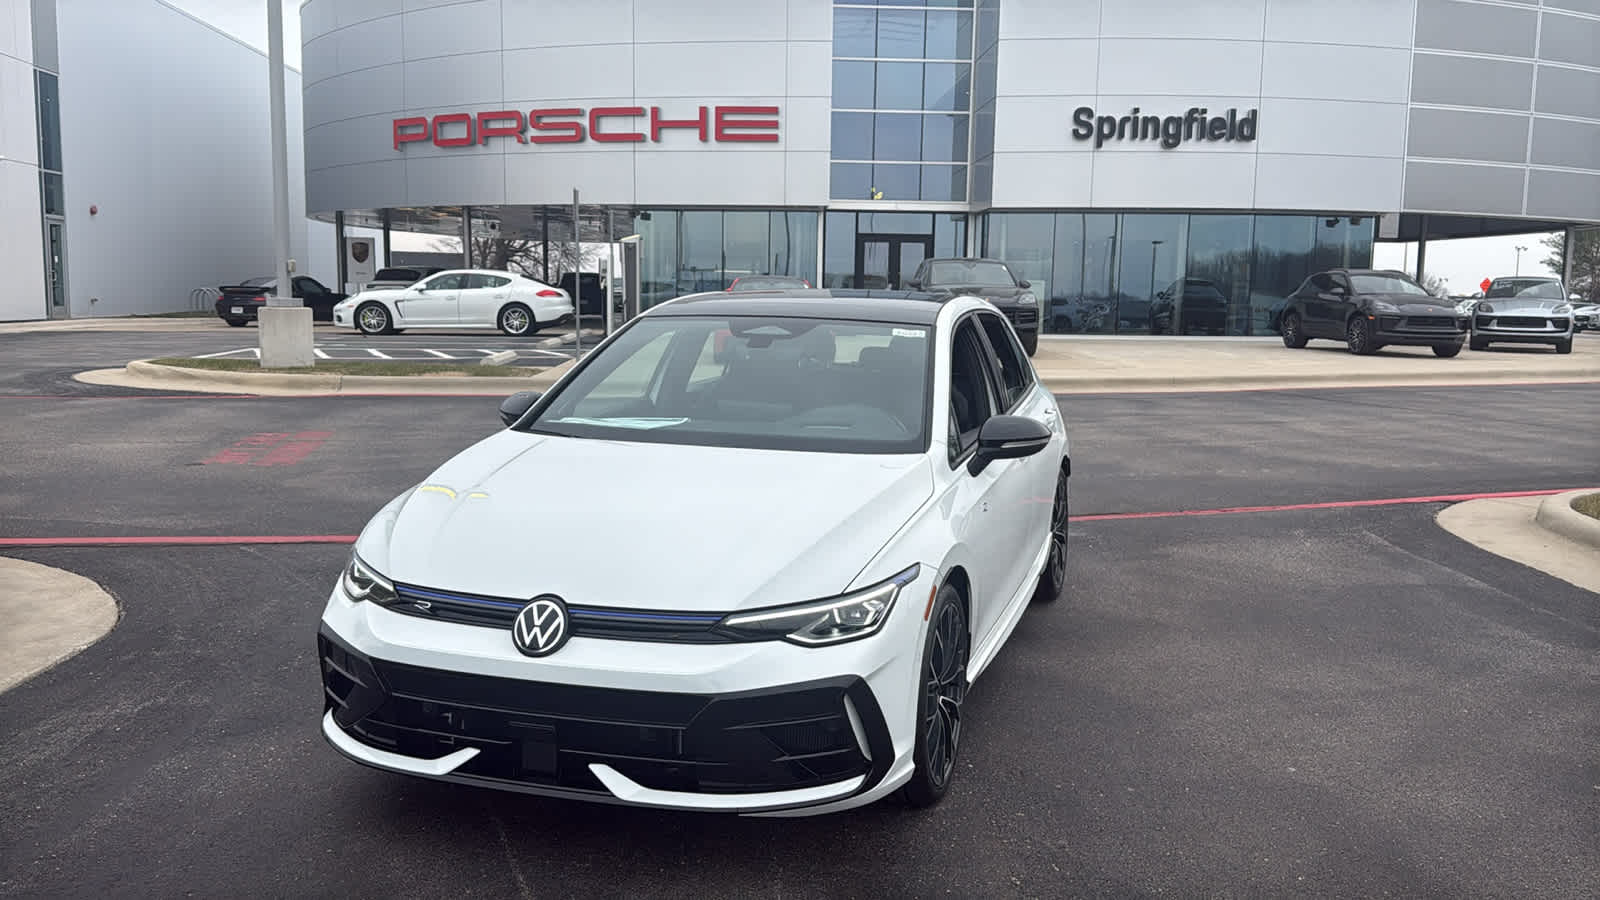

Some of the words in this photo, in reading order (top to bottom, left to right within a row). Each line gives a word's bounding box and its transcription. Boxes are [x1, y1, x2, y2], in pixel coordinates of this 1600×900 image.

[393, 105, 780, 151] PORSCHE
[1072, 106, 1258, 149] Springfield
[514, 600, 565, 653] VW
